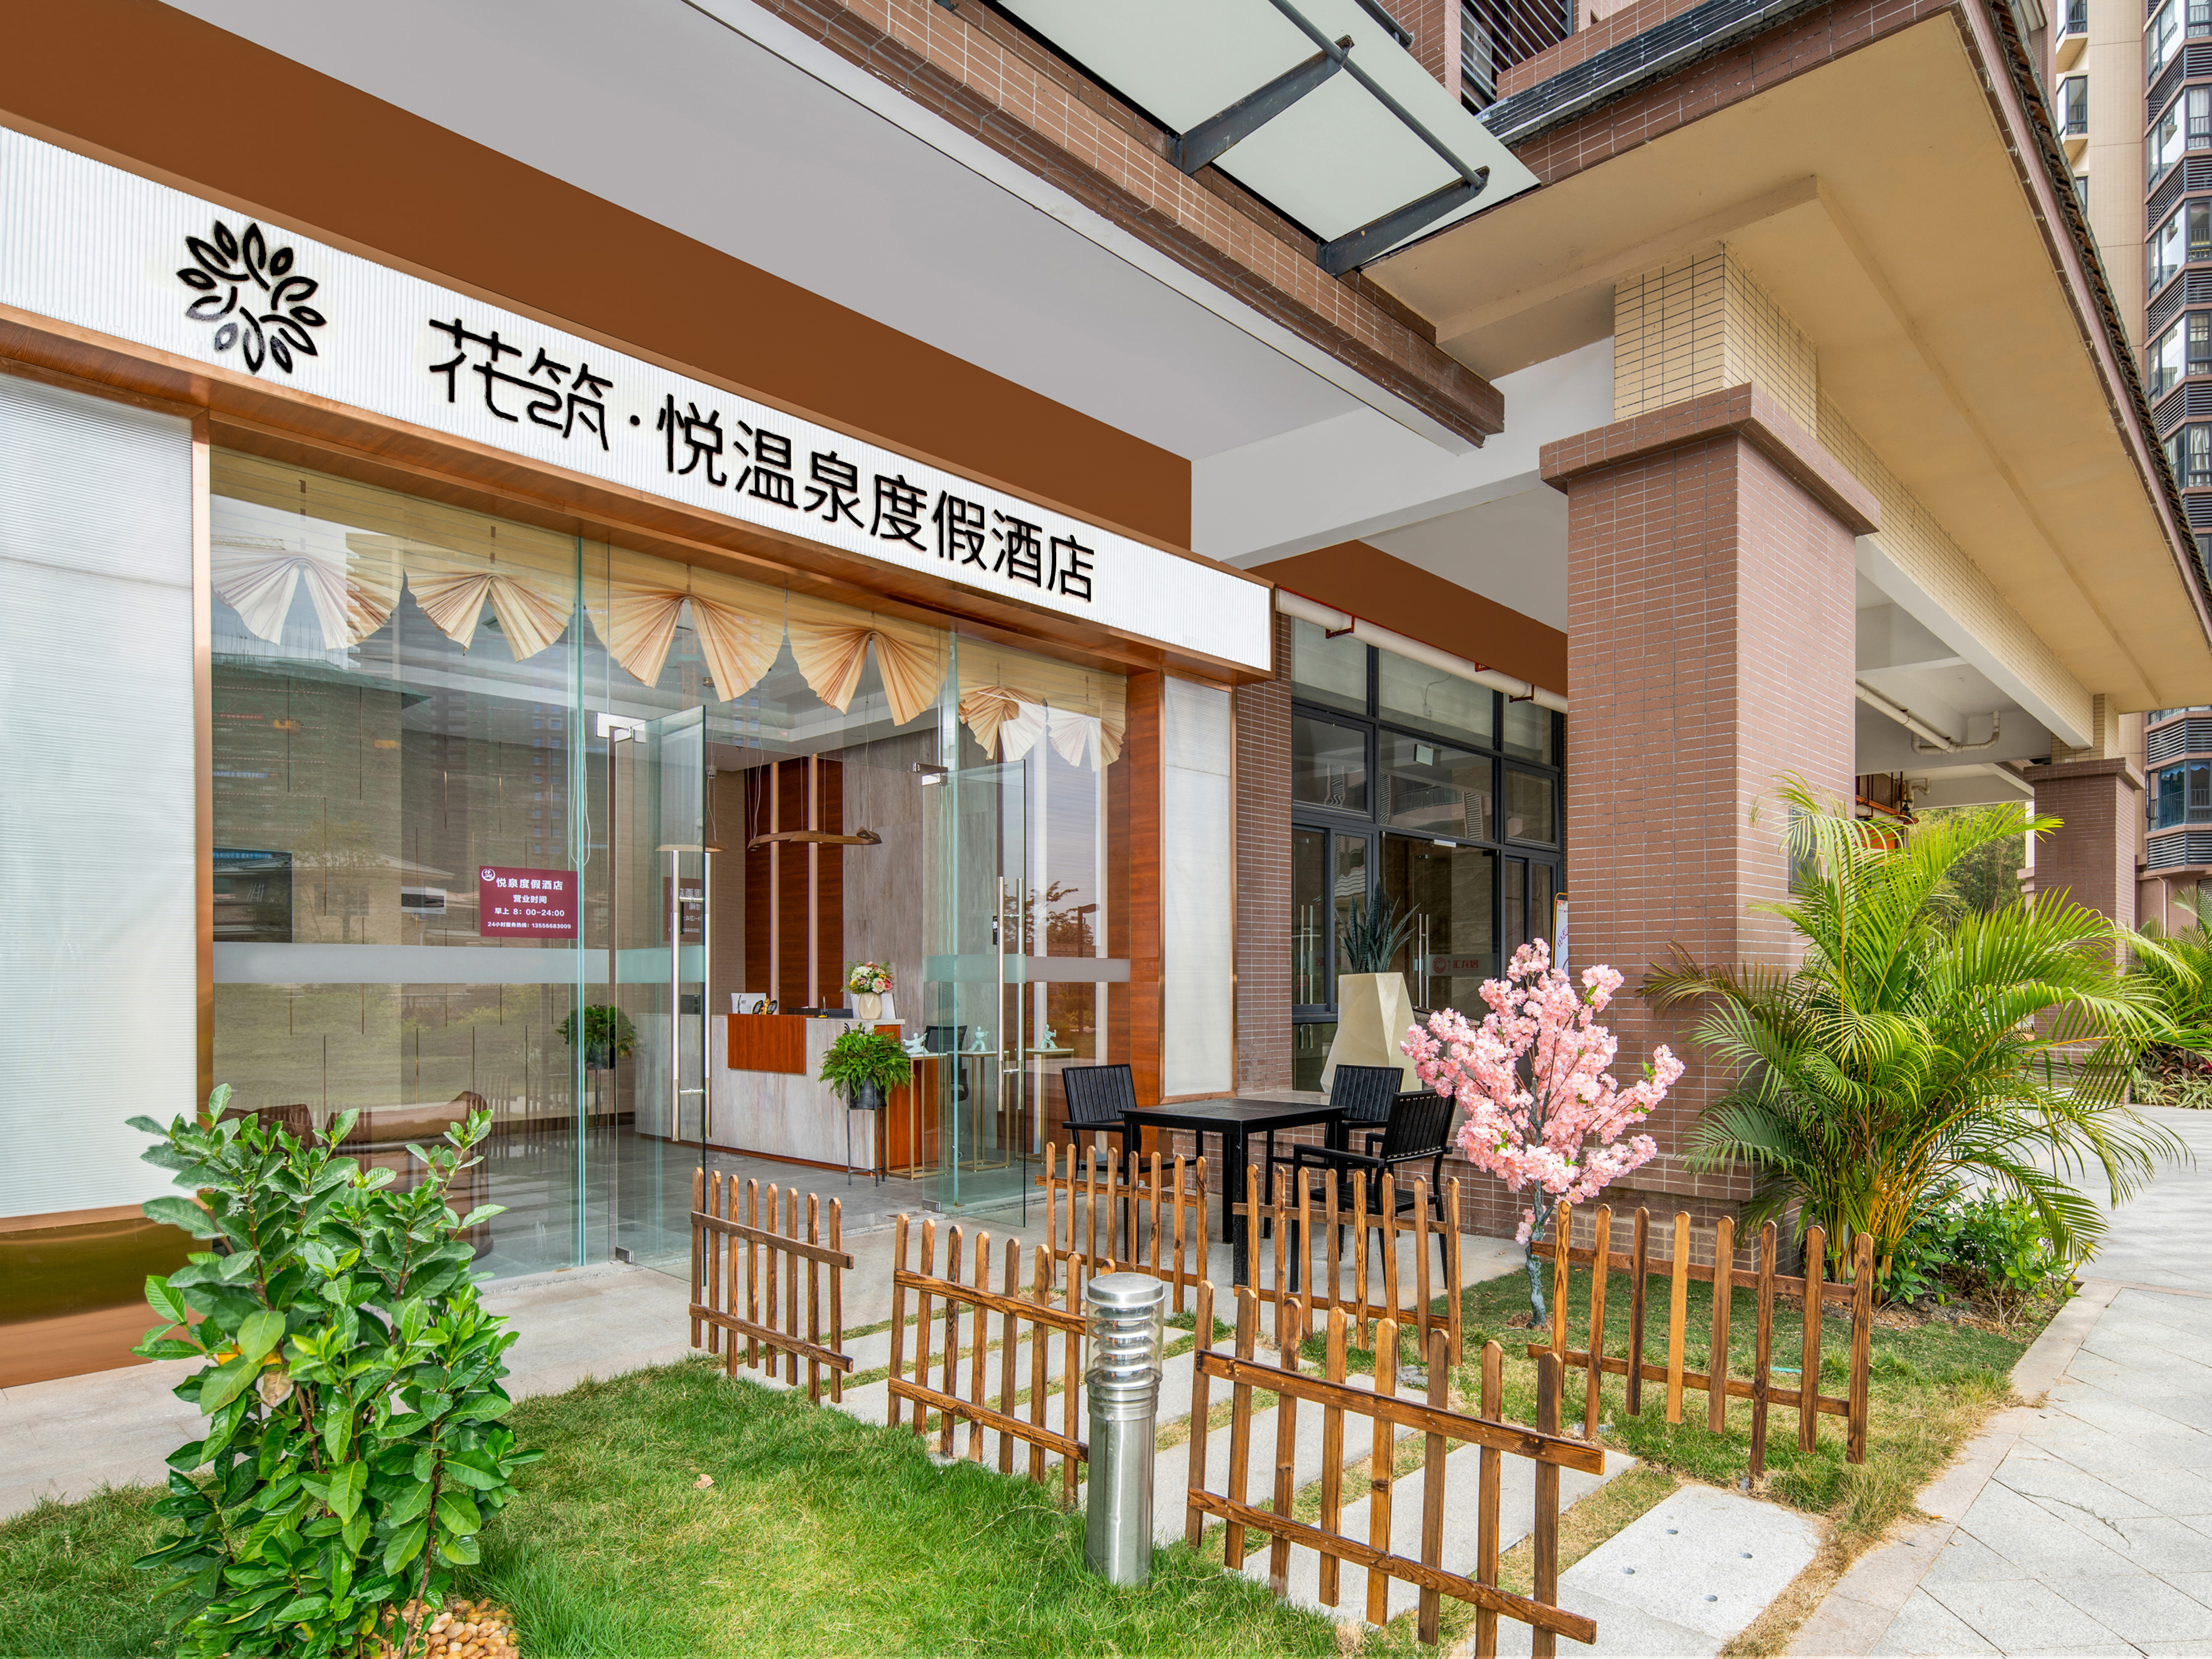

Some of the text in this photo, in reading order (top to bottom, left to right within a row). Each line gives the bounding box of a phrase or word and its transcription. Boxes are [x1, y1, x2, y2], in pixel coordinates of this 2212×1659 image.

[496, 878, 563, 890] 悦泉度假酒店
[513, 894, 547, 904] 营业时间
